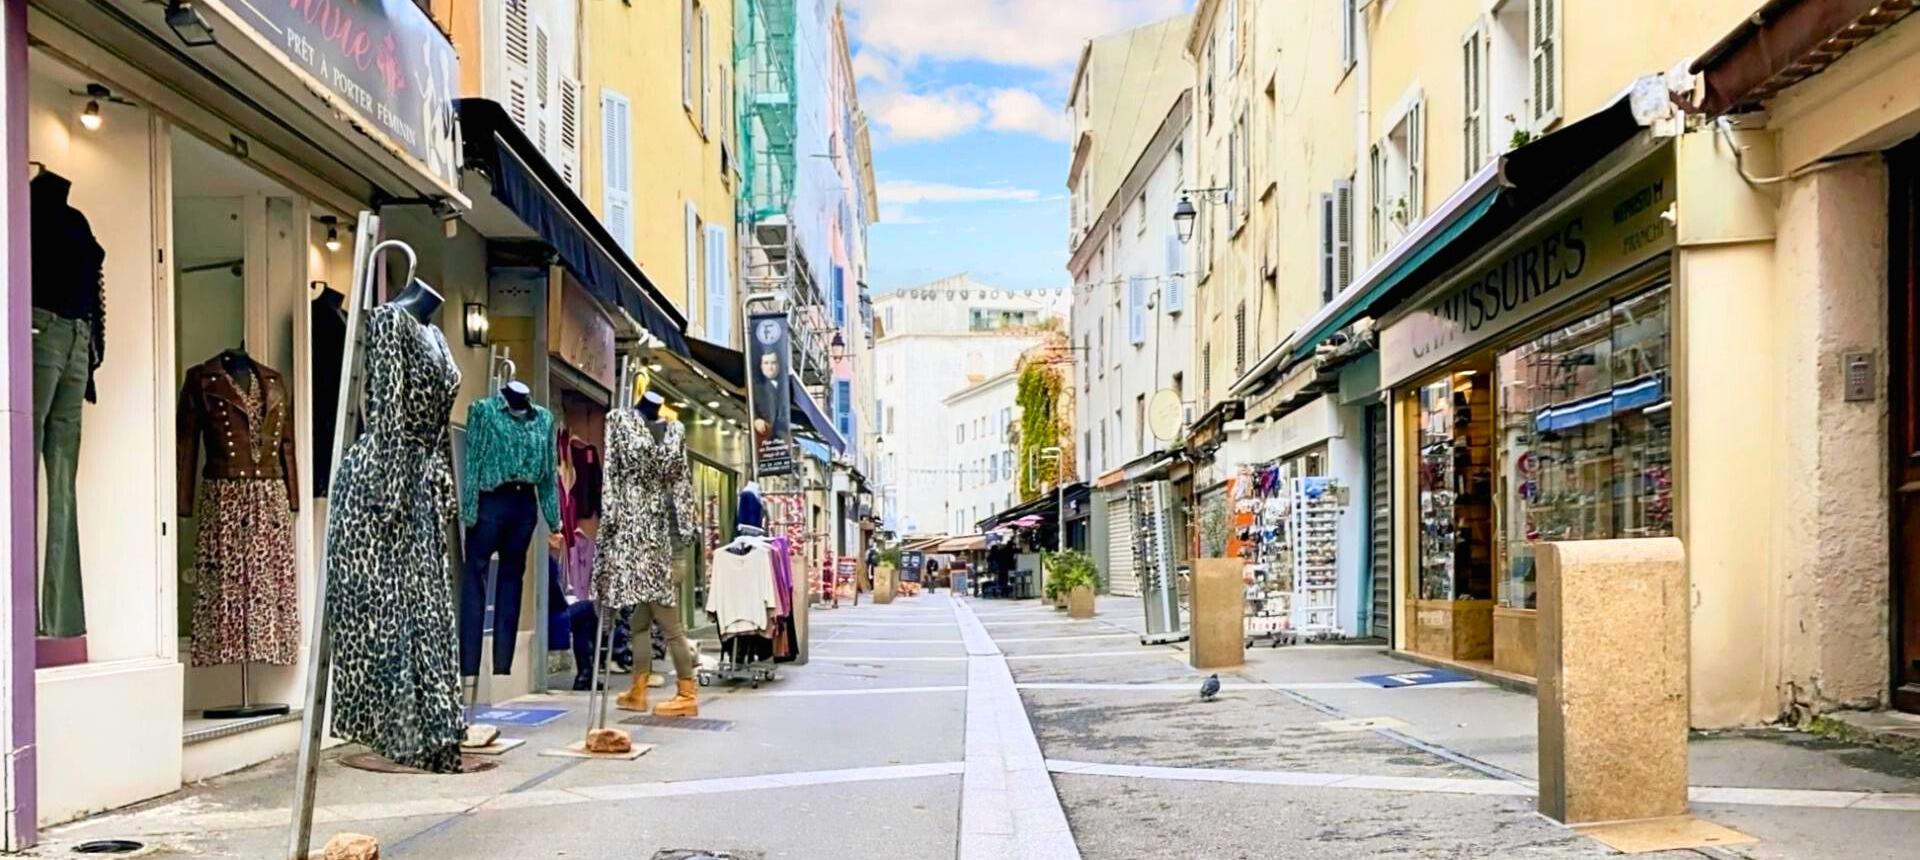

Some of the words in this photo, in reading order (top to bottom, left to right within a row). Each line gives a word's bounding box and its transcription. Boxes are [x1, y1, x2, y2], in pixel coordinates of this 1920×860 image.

[288, 28, 315, 66] PRÊT
[333, 67, 373, 113] PORTER
[377, 102, 416, 146] FÉMININ
